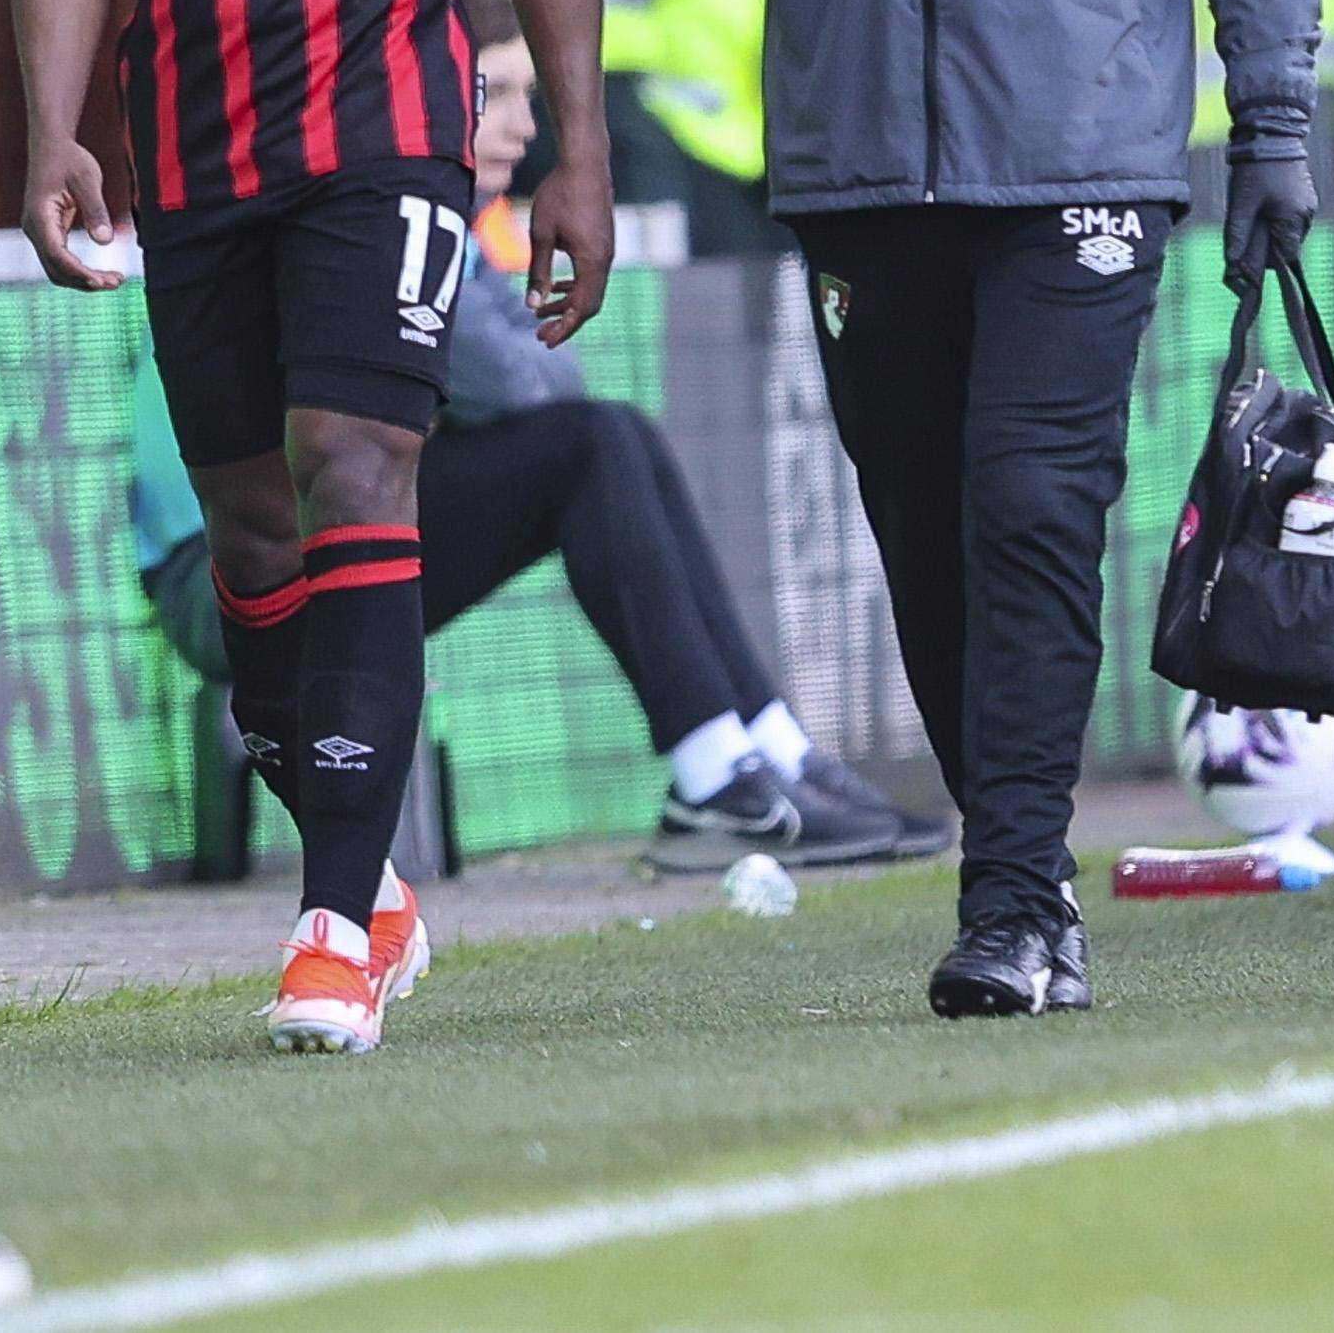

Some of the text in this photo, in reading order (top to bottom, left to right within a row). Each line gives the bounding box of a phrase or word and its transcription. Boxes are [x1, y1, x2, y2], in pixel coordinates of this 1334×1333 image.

[1062, 207, 1144, 239] SMcA
[397, 195, 466, 314] 17
[399, 326, 438, 348] umbro
